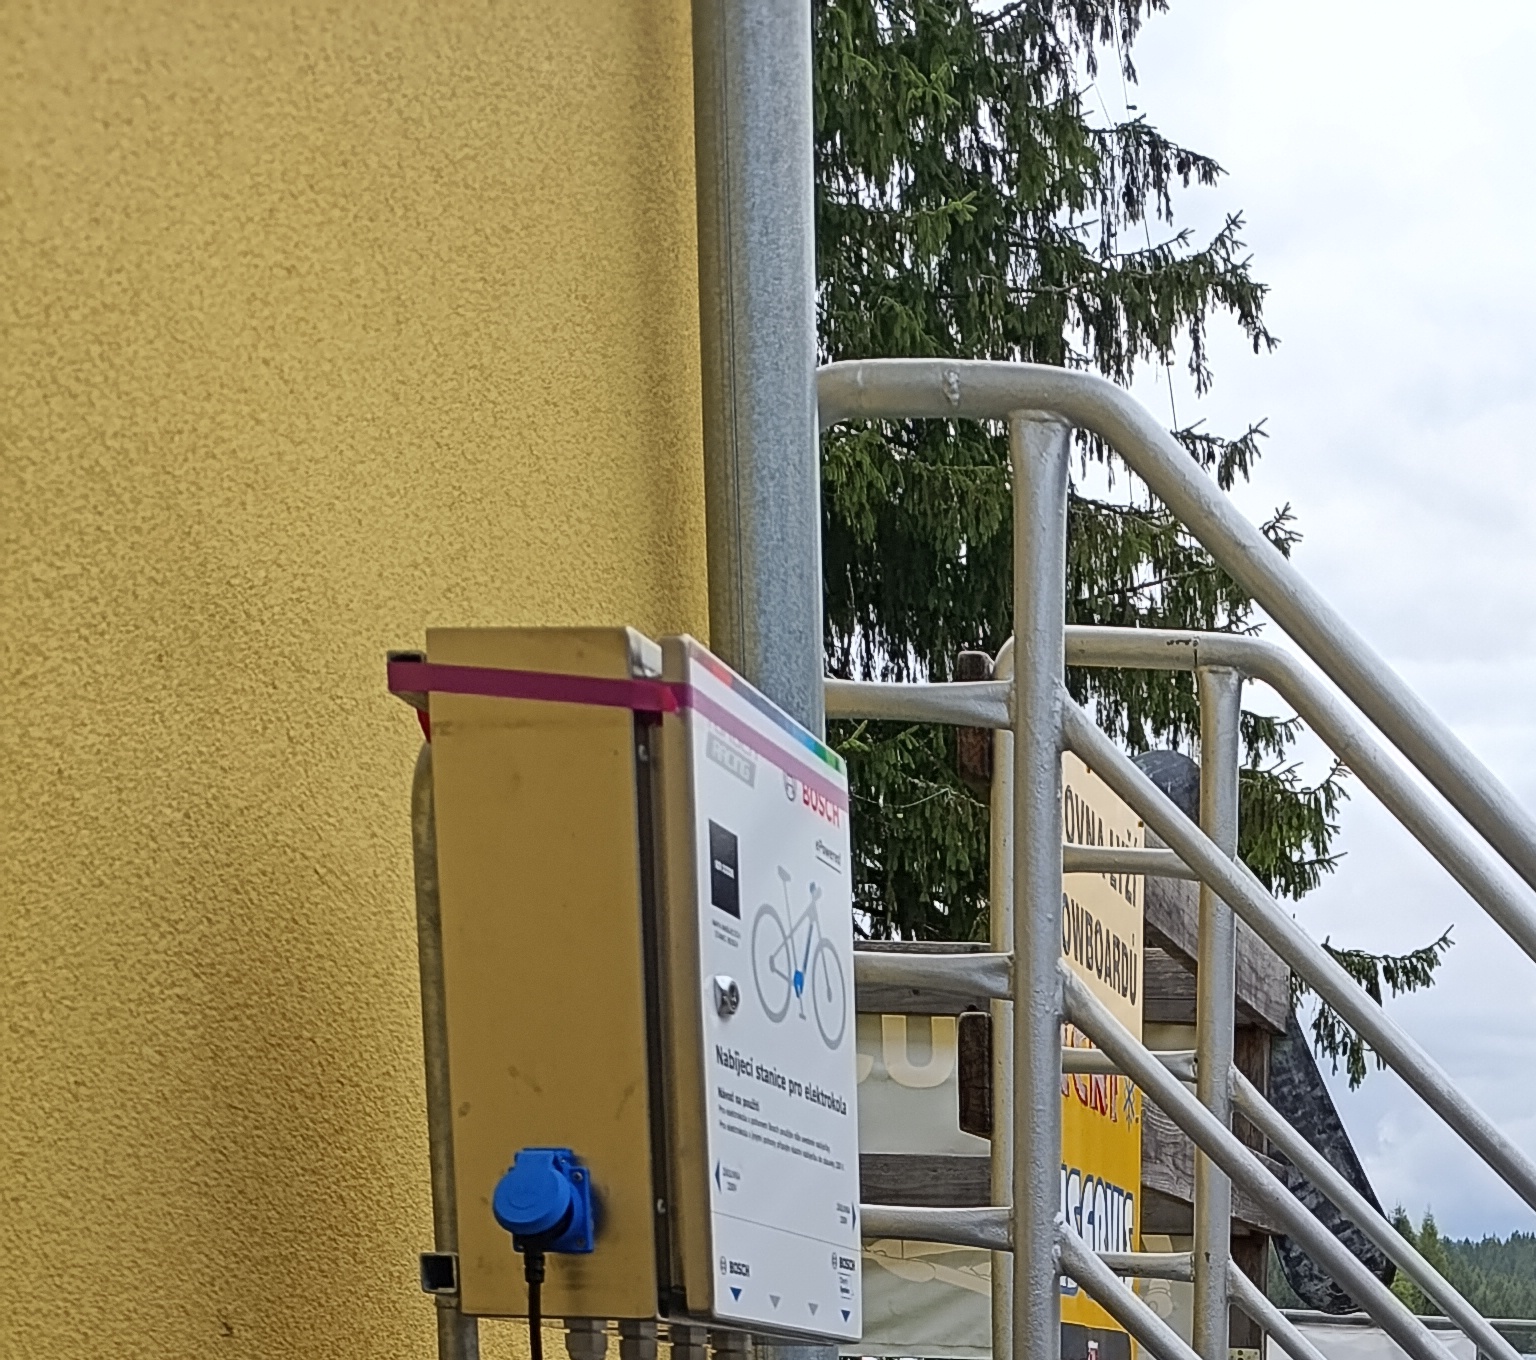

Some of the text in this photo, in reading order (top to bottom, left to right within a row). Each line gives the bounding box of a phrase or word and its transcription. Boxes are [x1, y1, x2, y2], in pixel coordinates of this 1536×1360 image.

[802, 784, 840, 829] BOSCH
[1062, 891, 1138, 1006] OWBOARDŮ
[756, 1064, 786, 1091] stanice
[789, 1078, 803, 1097] pro
[804, 1082, 847, 1115] elektrokola
